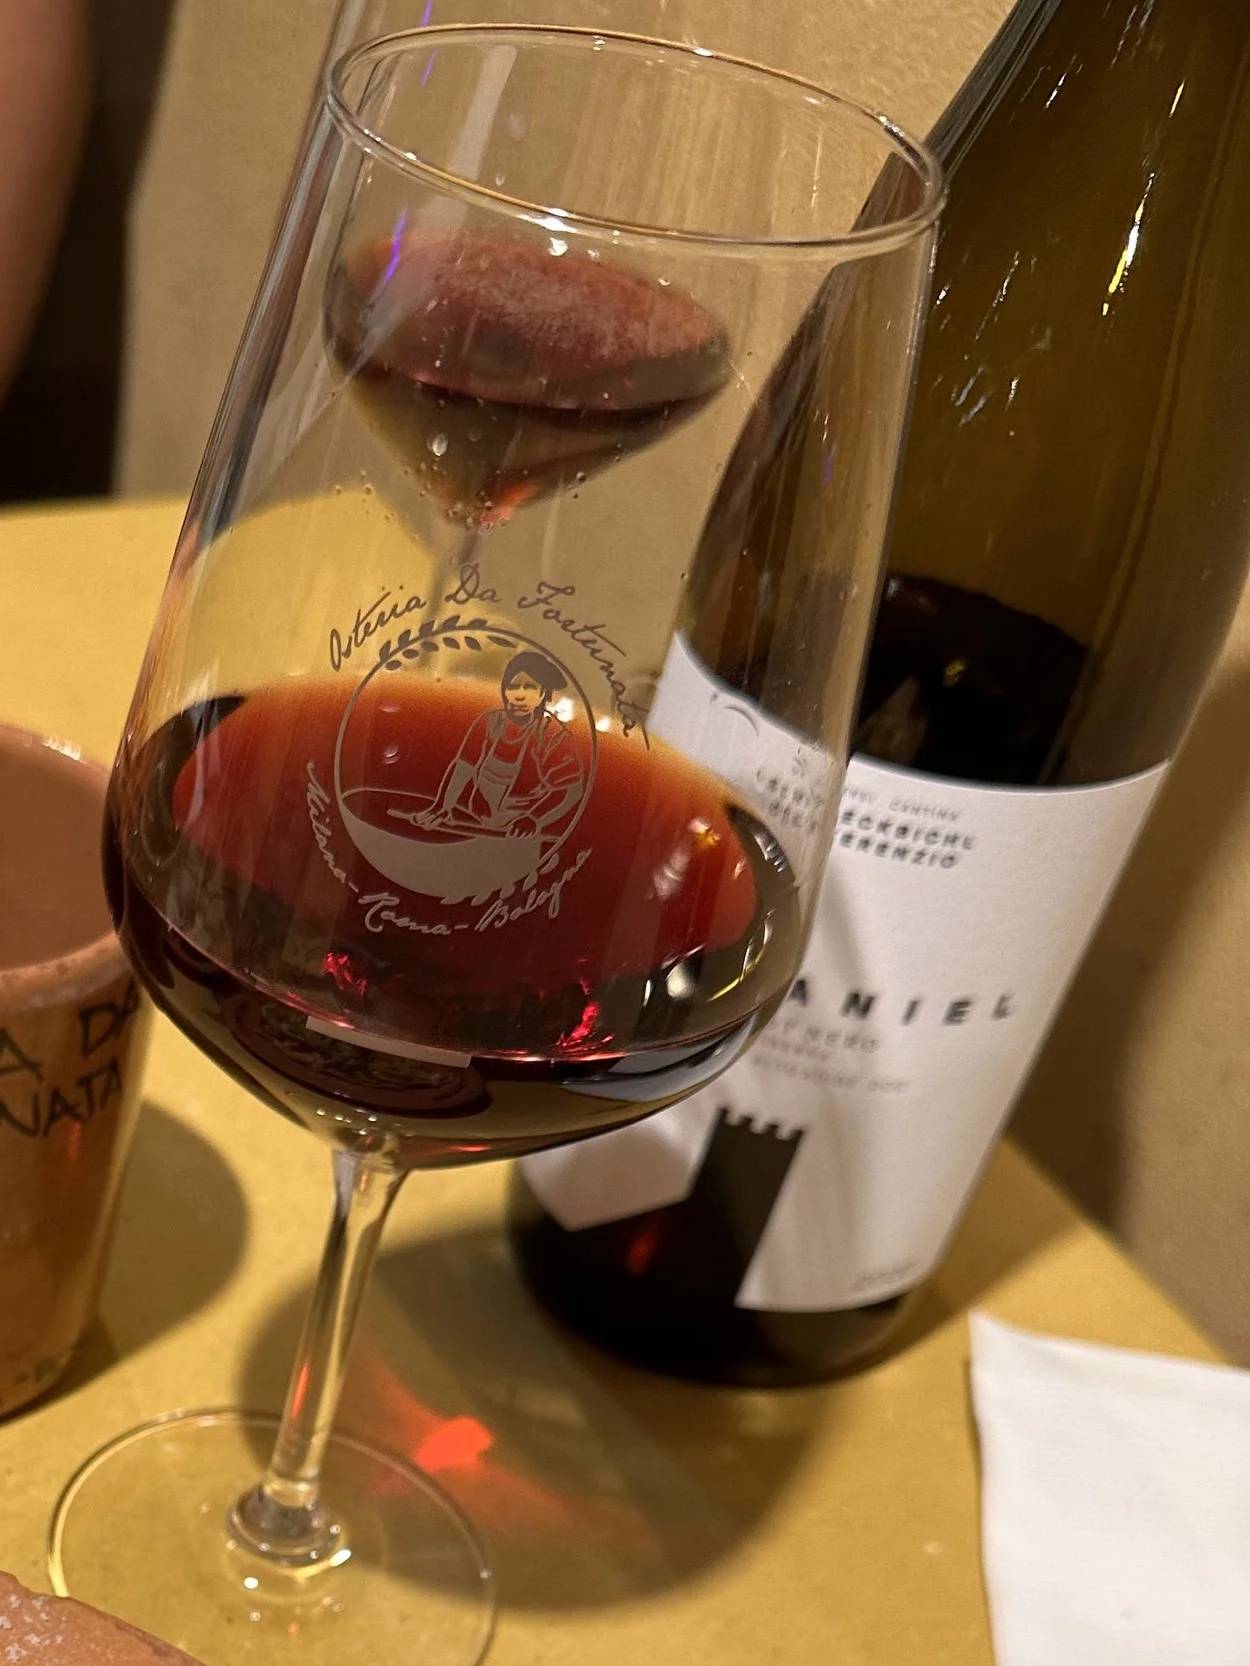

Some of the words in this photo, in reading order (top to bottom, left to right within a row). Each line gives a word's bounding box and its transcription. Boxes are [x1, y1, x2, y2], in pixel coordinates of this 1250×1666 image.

[329, 586, 427, 672] Osteria
[444, 562, 501, 605] Da
[518, 581, 650, 750] Fortunata
[835, 829, 959, 870] ERENZIO
[788, 977, 1017, 1027] ANIEL
